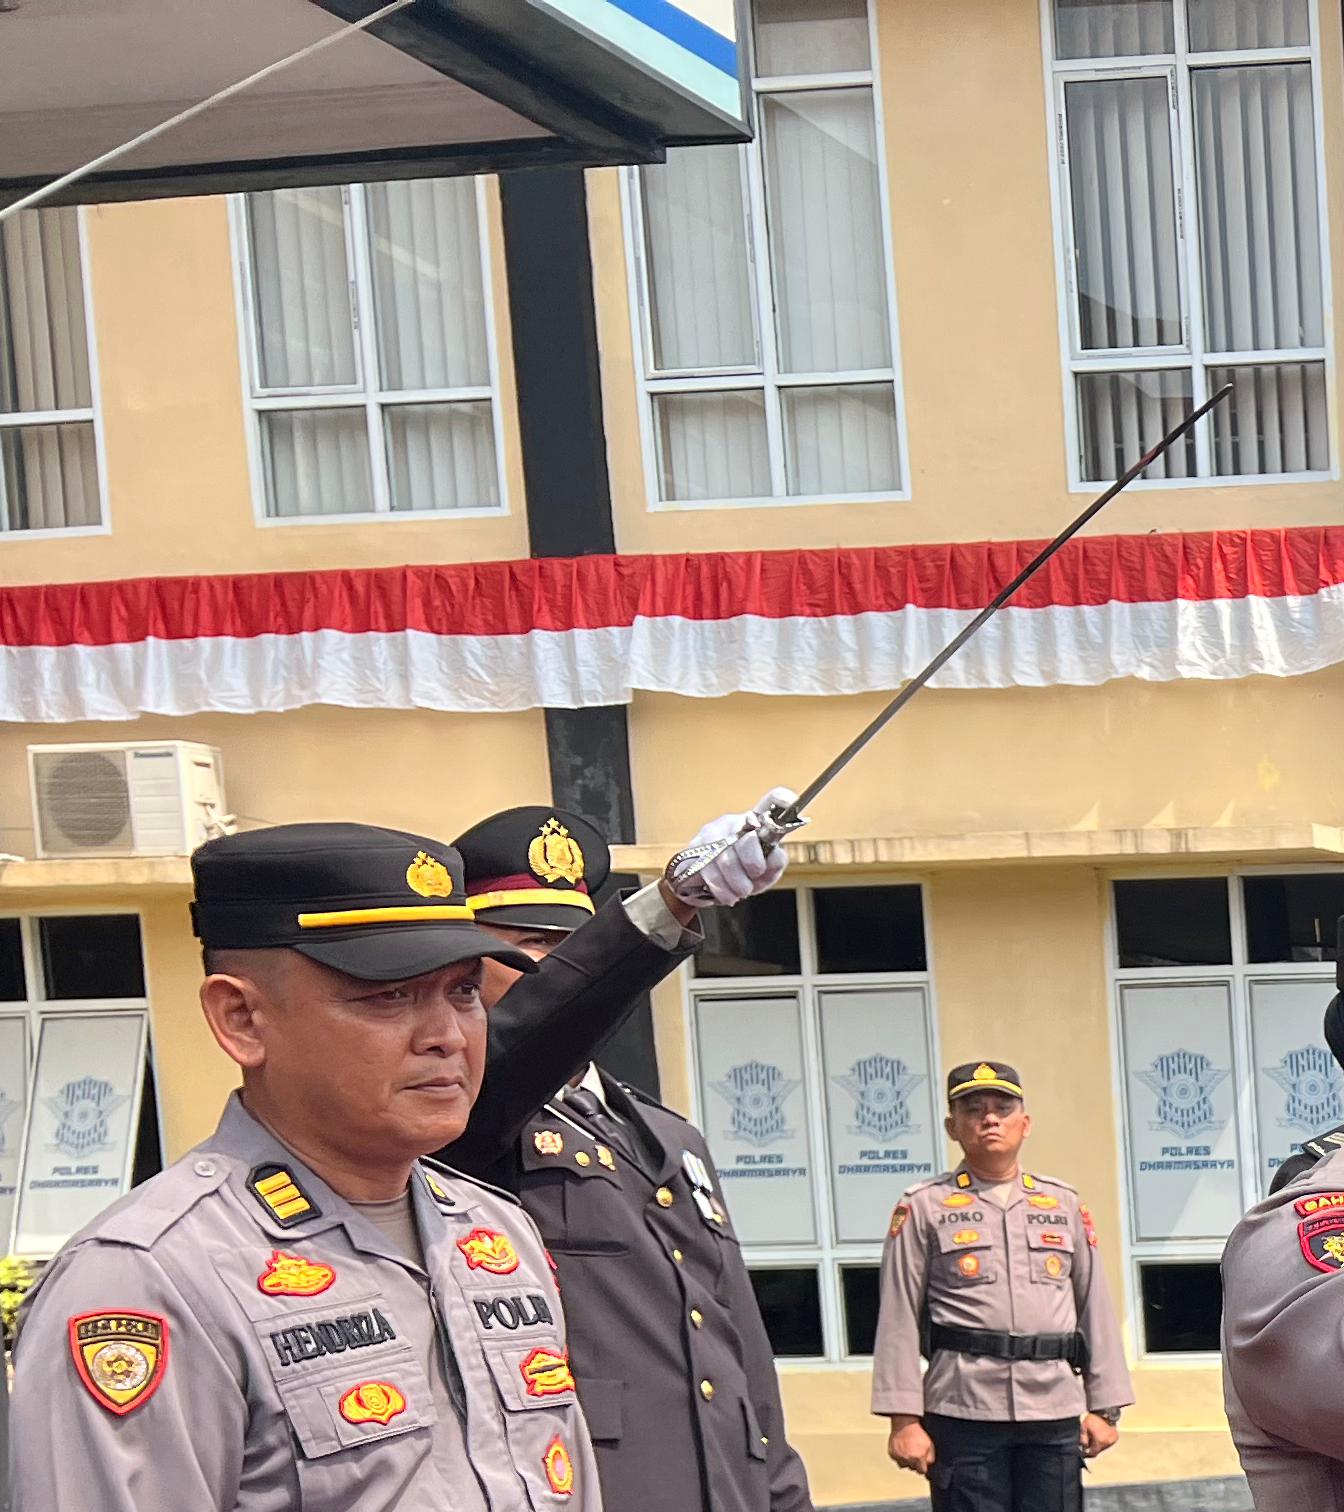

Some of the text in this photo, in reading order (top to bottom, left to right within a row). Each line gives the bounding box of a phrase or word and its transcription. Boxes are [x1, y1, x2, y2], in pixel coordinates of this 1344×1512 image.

[859, 1149, 908, 1160] POLRES
[1161, 1146, 1211, 1157] POLRES
[736, 1153, 783, 1165] POLRES
[938, 1211, 984, 1225] JOKO
[1026, 1213, 1068, 1226] POLRI
